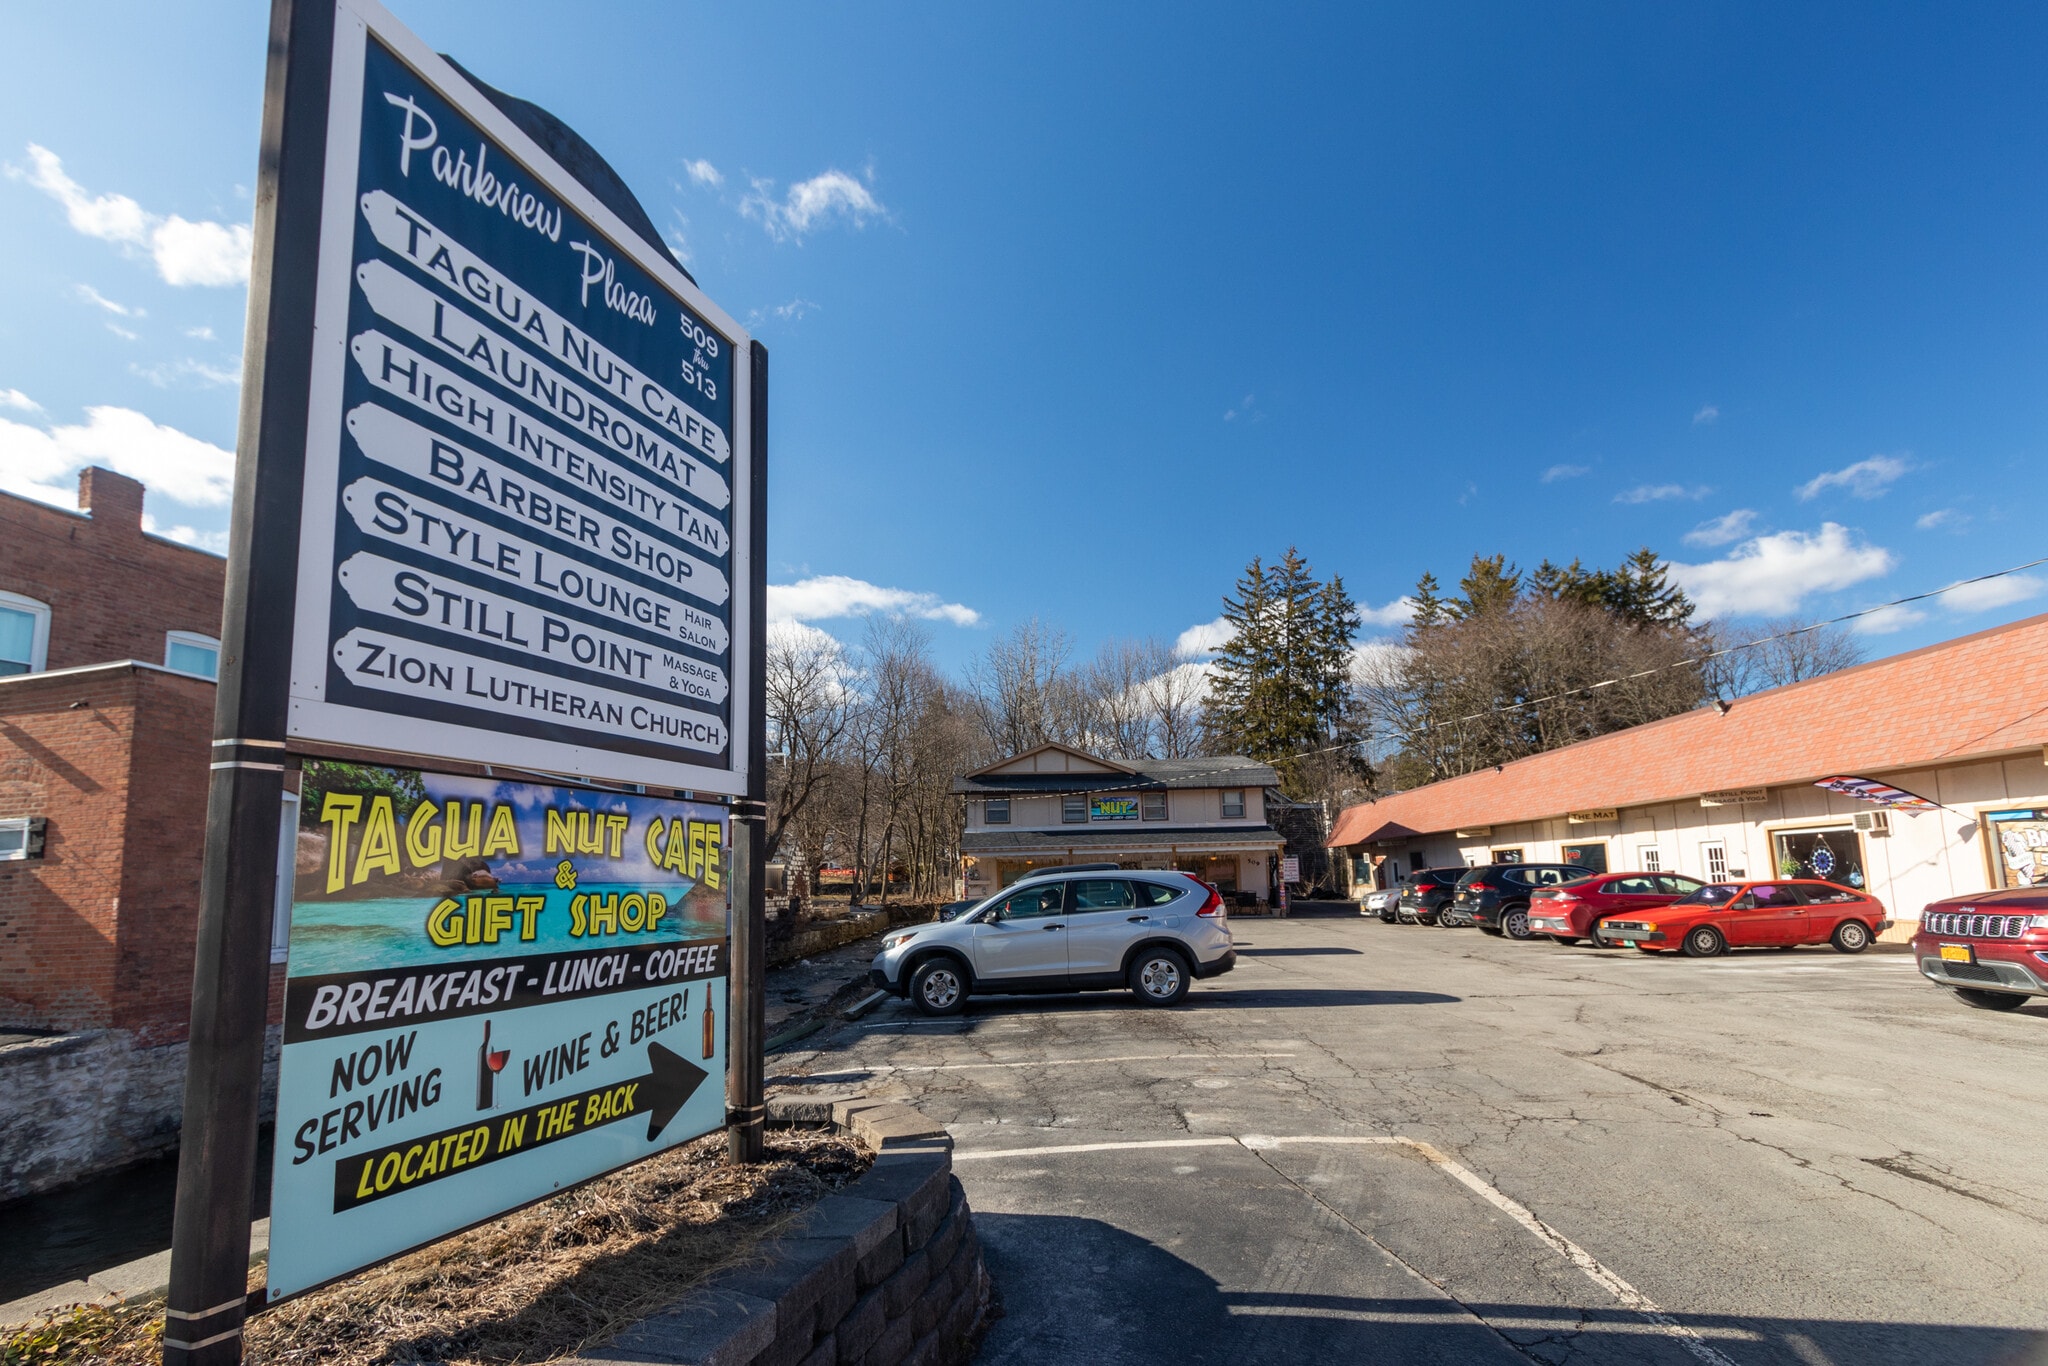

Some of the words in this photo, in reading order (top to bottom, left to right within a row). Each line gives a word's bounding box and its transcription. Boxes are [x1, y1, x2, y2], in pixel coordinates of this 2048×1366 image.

[383, 91, 561, 243] Parkview
[569, 240, 656, 327] Plaza
[395, 206, 549, 346] TAGUA
[562, 323, 633, 396] NUT
[641, 383, 716, 455] CAFE
[680, 312, 718, 357] 509
[433, 300, 696, 487] LAUNDROMAT
[681, 359, 717, 401] 513
[380, 344, 494, 436] HIGH
[508, 412, 667, 520] INTENSITY
[672, 502, 718, 550] TAN
[430, 438, 600, 547] BARBER
[611, 526, 693, 584] SHOP
[372, 492, 521, 578] STYLE
[533, 551, 671, 631] LOUNGE
[392, 571, 528, 648] STILL
[542, 616, 653, 680] POINT
[679, 626, 716, 650] SALON
[684, 608, 713, 631] HAIR
[355, 640, 453, 691] ZION
[466, 666, 623, 726] LUTHERAN
[631, 705, 719, 745] CHURCH
[662, 654, 718, 682] MASSAGE
[669, 675, 679, 690] &
[681, 678, 712, 699] YOGA
[321, 791, 519, 894] TAGUA
[546, 809, 629, 857] NUT
[646, 817, 721, 890] CAFE
[1100, 801, 1128, 814] NUT
[1593, 811, 1615, 819] MAT
[427, 896, 545, 946] GIFT
[569, 893, 667, 937] SHOP
[555, 860, 578, 890] &
[305, 964, 524, 1030] BREAKFAST
[542, 953, 628, 996] LUNCH
[644, 945, 719, 981] COFFEE
[330, 1030, 418, 1098] NOW
[523, 1031, 592, 1097] WINE
[601, 1021, 620, 1059] &
[630, 988, 690, 1046] BEER!
[292, 1068, 442, 1165] SERVING
[355, 1126, 490, 1199] LOCATED
[498, 1118, 524, 1153] IN
[537, 1101, 575, 1142] THE
[584, 1083, 639, 1122] BACK
